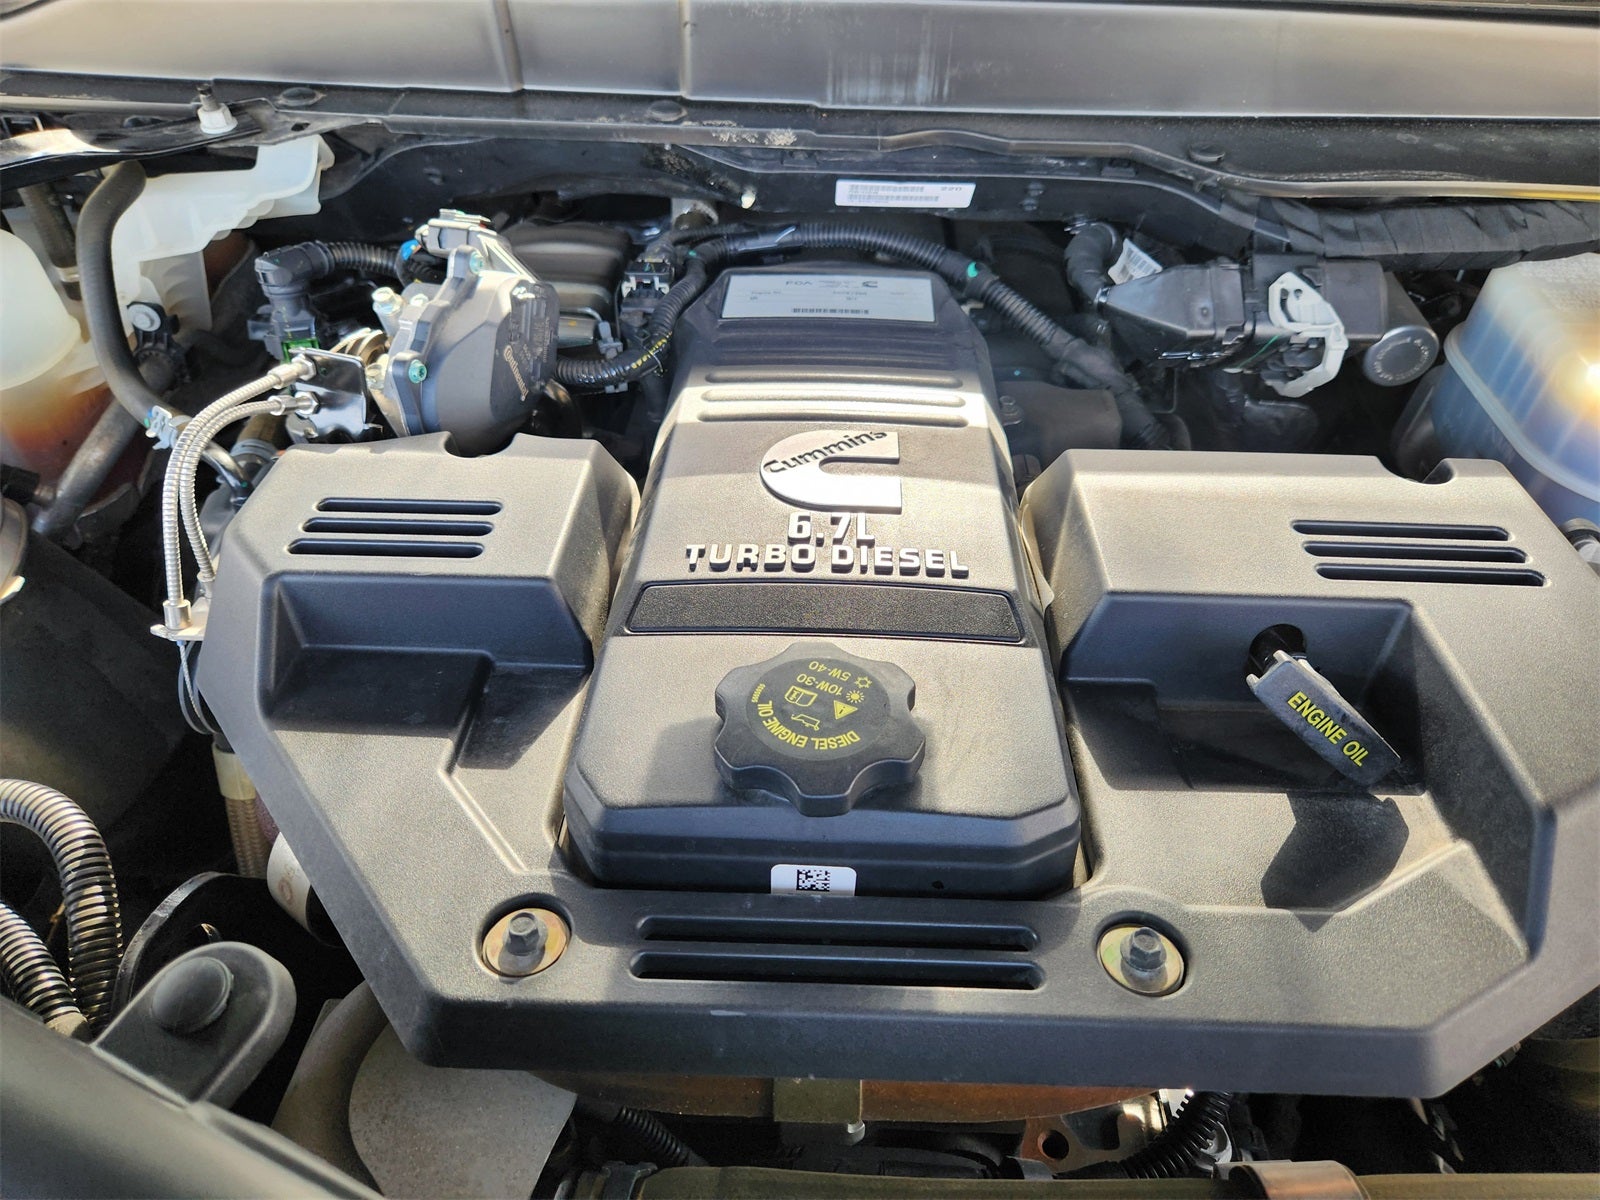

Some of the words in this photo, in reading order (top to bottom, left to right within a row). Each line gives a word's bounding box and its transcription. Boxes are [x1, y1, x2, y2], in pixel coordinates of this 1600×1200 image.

[762, 430, 889, 473] Cummins
[787, 511, 875, 547] 6.7L
[686, 543, 816, 574] TURBO
[831, 545, 970, 579] DIESEL
[796, 673, 844, 697] 10W-30
[808, 660, 852, 682] 5W-40
[757, 700, 774, 718] OIL
[762, 716, 809, 749] ENGINE
[811, 730, 861, 750] DIESEL
[1287, 690, 1348, 745] ENGINE
[1342, 740, 1369, 767] OIL
